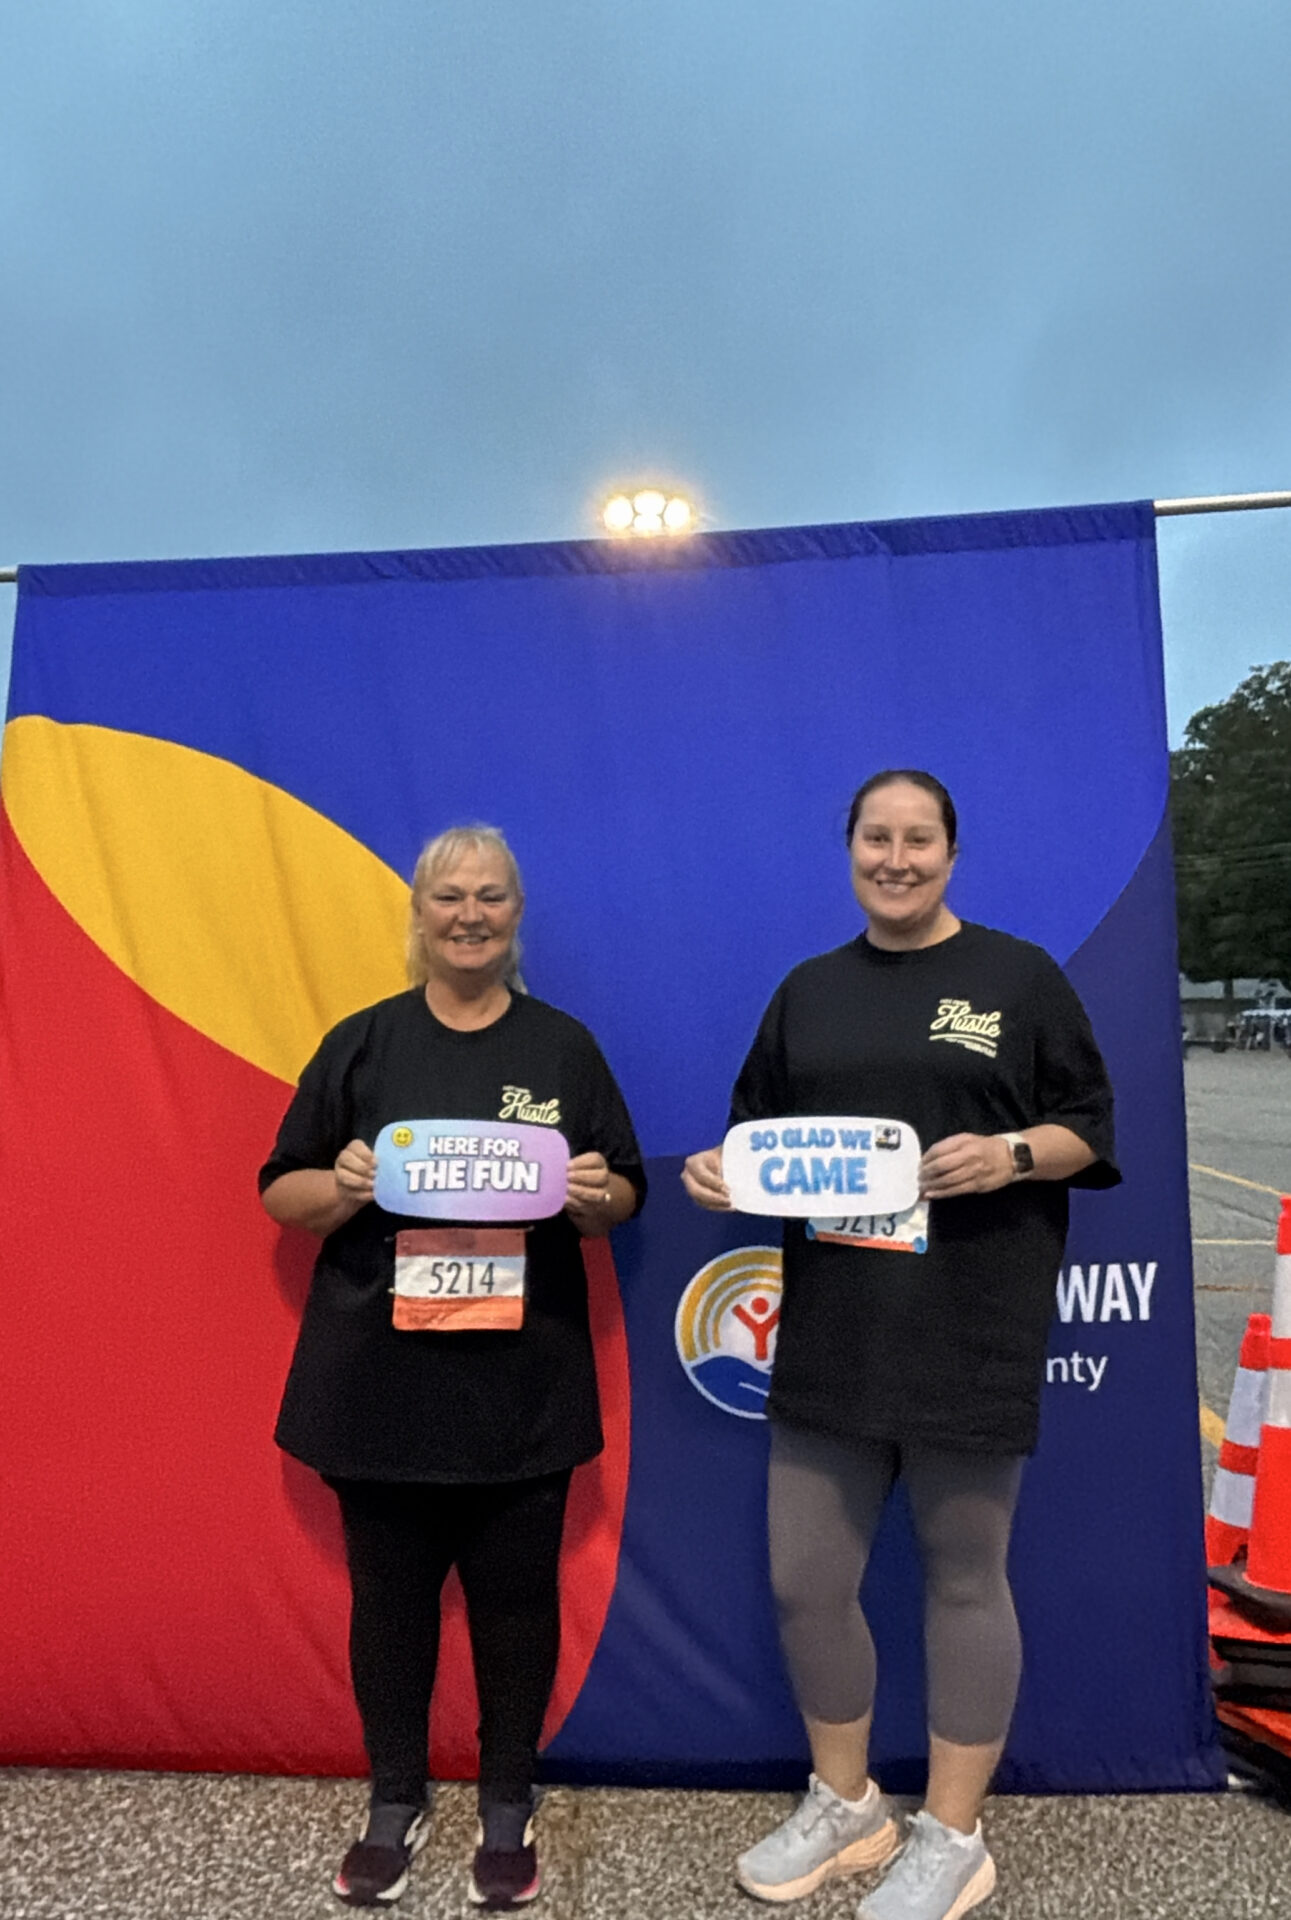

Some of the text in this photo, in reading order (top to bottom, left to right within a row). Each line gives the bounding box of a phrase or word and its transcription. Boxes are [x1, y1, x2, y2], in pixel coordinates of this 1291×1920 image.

[930, 1004, 1001, 1038] Hustle
[498, 1091, 561, 1124] Hustle
[429, 1136, 520, 1157] HERE FOR
[750, 1128, 873, 1151] SO GLAD WE
[405, 1159, 540, 1192] THE FUN
[759, 1156, 868, 1195] CAME
[428, 1261, 495, 1294] 5214
[1056, 1262, 1158, 1323] WAY
